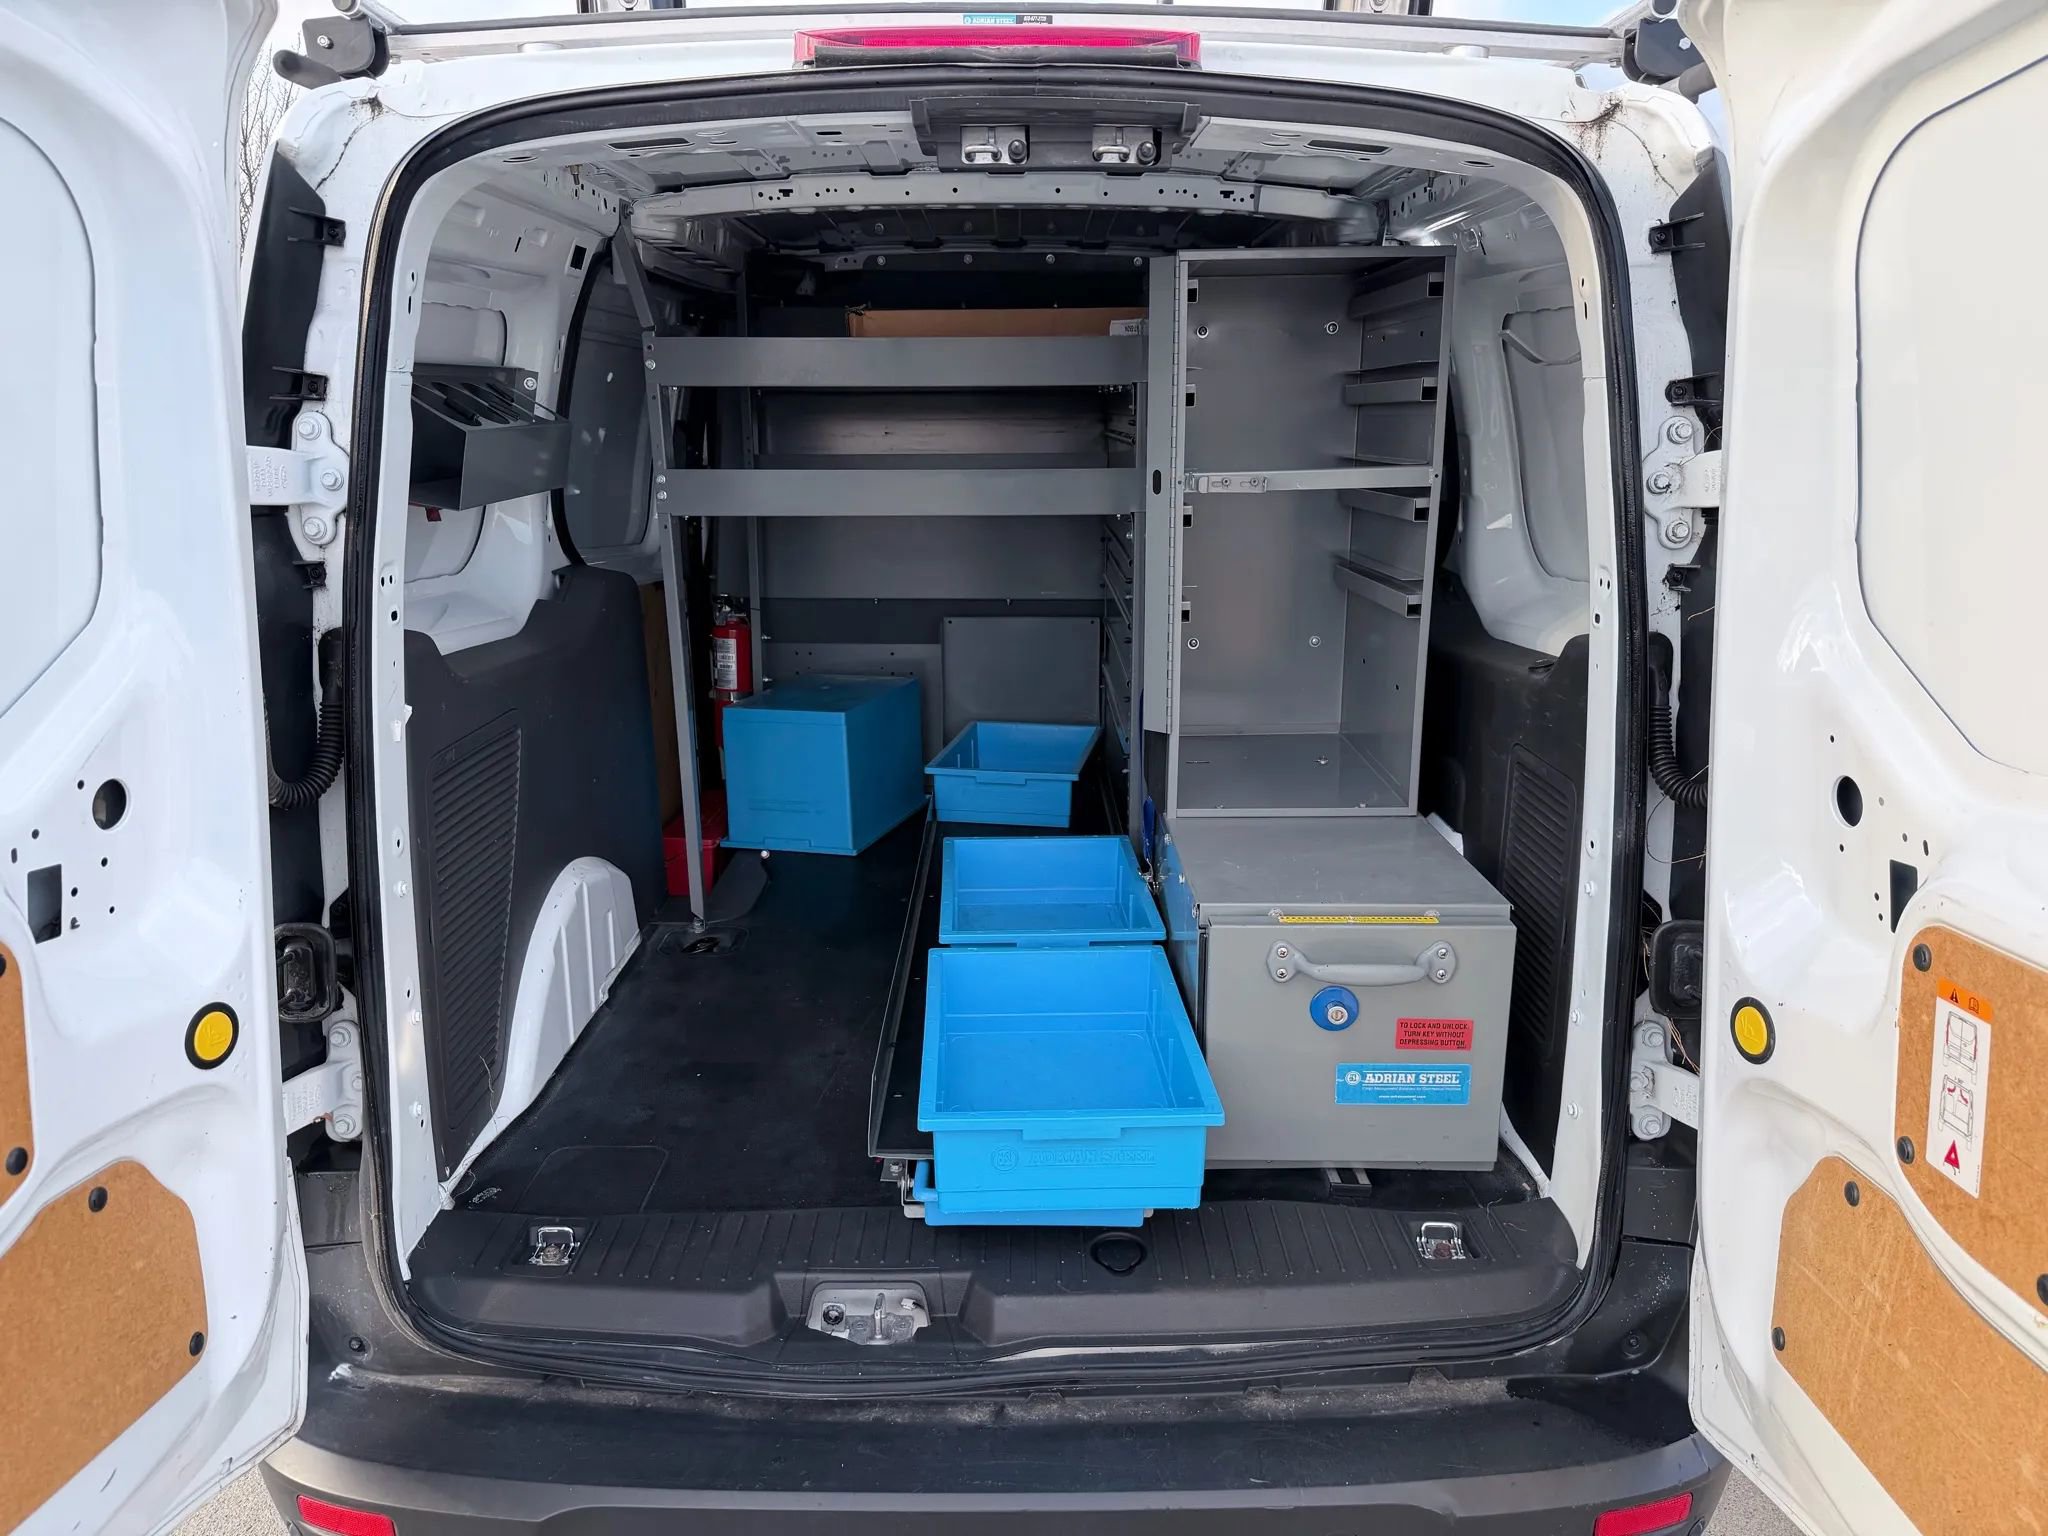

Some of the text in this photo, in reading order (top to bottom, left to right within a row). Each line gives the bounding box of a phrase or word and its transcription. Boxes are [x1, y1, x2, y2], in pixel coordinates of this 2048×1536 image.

[1399, 1038, 1439, 1046] DEPRESSING
[1364, 1073, 1416, 1084] ADRIAN
[1419, 1073, 1460, 1084] STEEL
[1028, 1149, 1097, 1163] ADRIAN
[1101, 1148, 1156, 1163] STEEL
